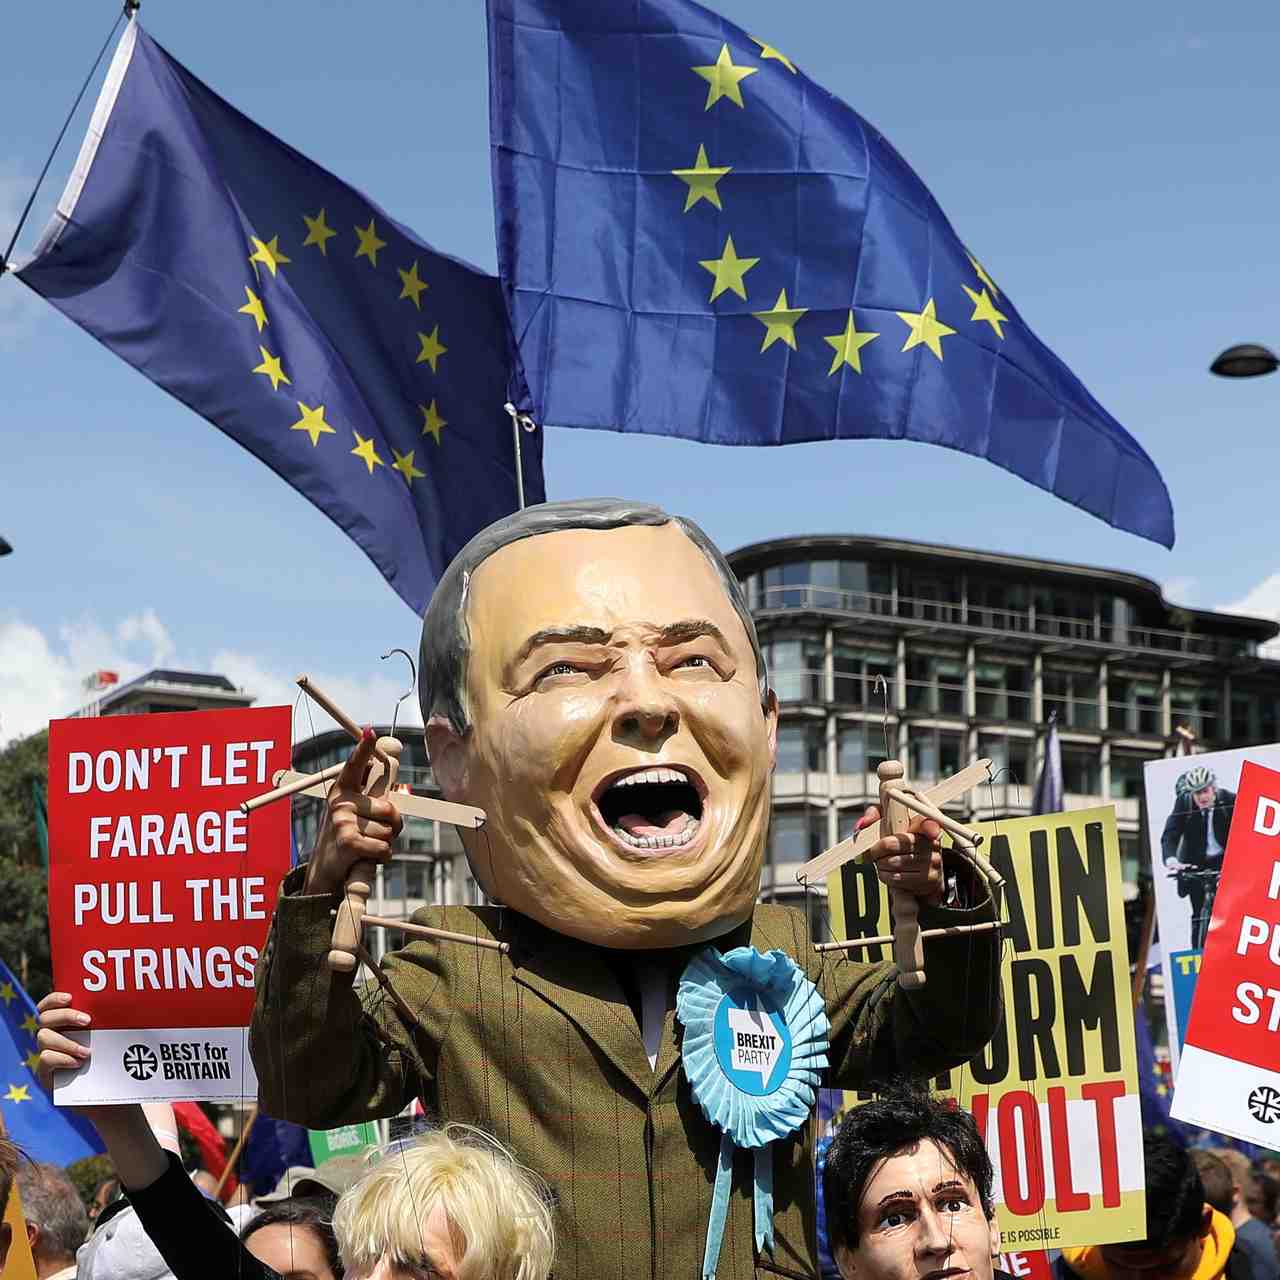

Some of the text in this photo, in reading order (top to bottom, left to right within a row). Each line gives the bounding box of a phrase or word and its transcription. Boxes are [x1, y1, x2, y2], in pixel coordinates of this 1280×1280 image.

[68, 741, 274, 794] DON'T LET
[89, 809, 248, 858] FARAGE
[73, 876, 266, 926] PULL THE
[841, 824, 1110, 962] RAIN
[82, 946, 259, 992] STRINGS
[159, 1043, 229, 1062] BEST for
[736, 1032, 776, 1051] BREXIT
[738, 1050, 771, 1065] PARTY
[162, 1059, 231, 1081] BRITAIN
[1008, 1232, 1017, 1243] IS
[1018, 1227, 1061, 1242] POSSIBLE
